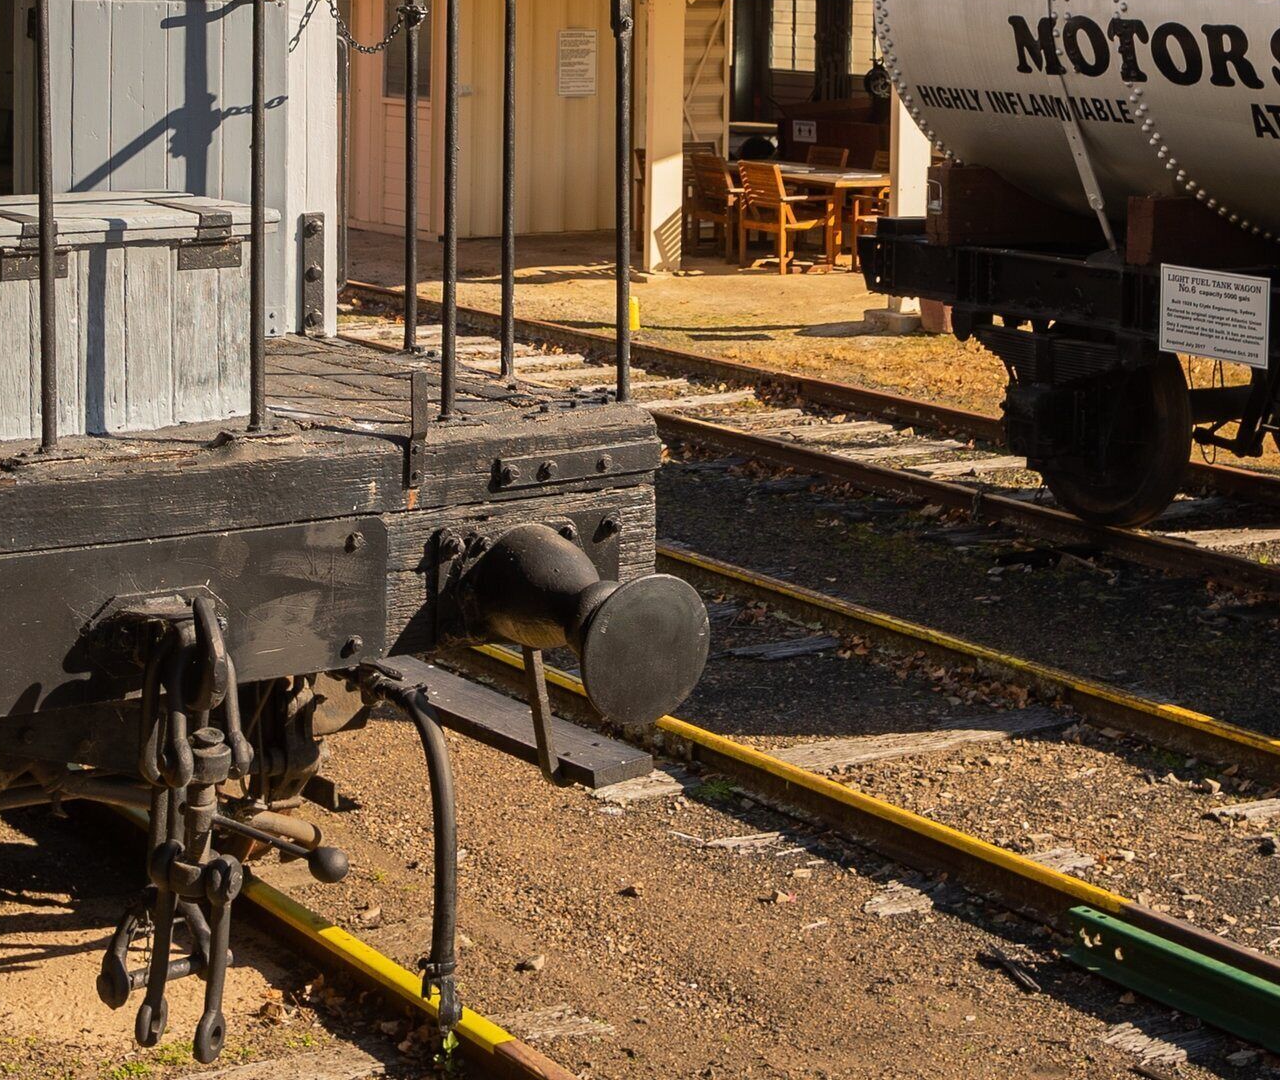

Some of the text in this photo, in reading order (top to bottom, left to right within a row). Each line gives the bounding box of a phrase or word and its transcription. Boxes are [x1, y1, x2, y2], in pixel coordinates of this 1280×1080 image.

[1007, 15, 1264, 89] MOTOR
[917, 85, 1135, 124] HIGHLY INFLAMMABLE
[1168, 274, 1262, 294] LIGHT FUEL TANK WAGON
[1179, 283, 1196, 294] No.6
[1199, 289, 1222, 299] capacity
[1238, 295, 1250, 303] gals
